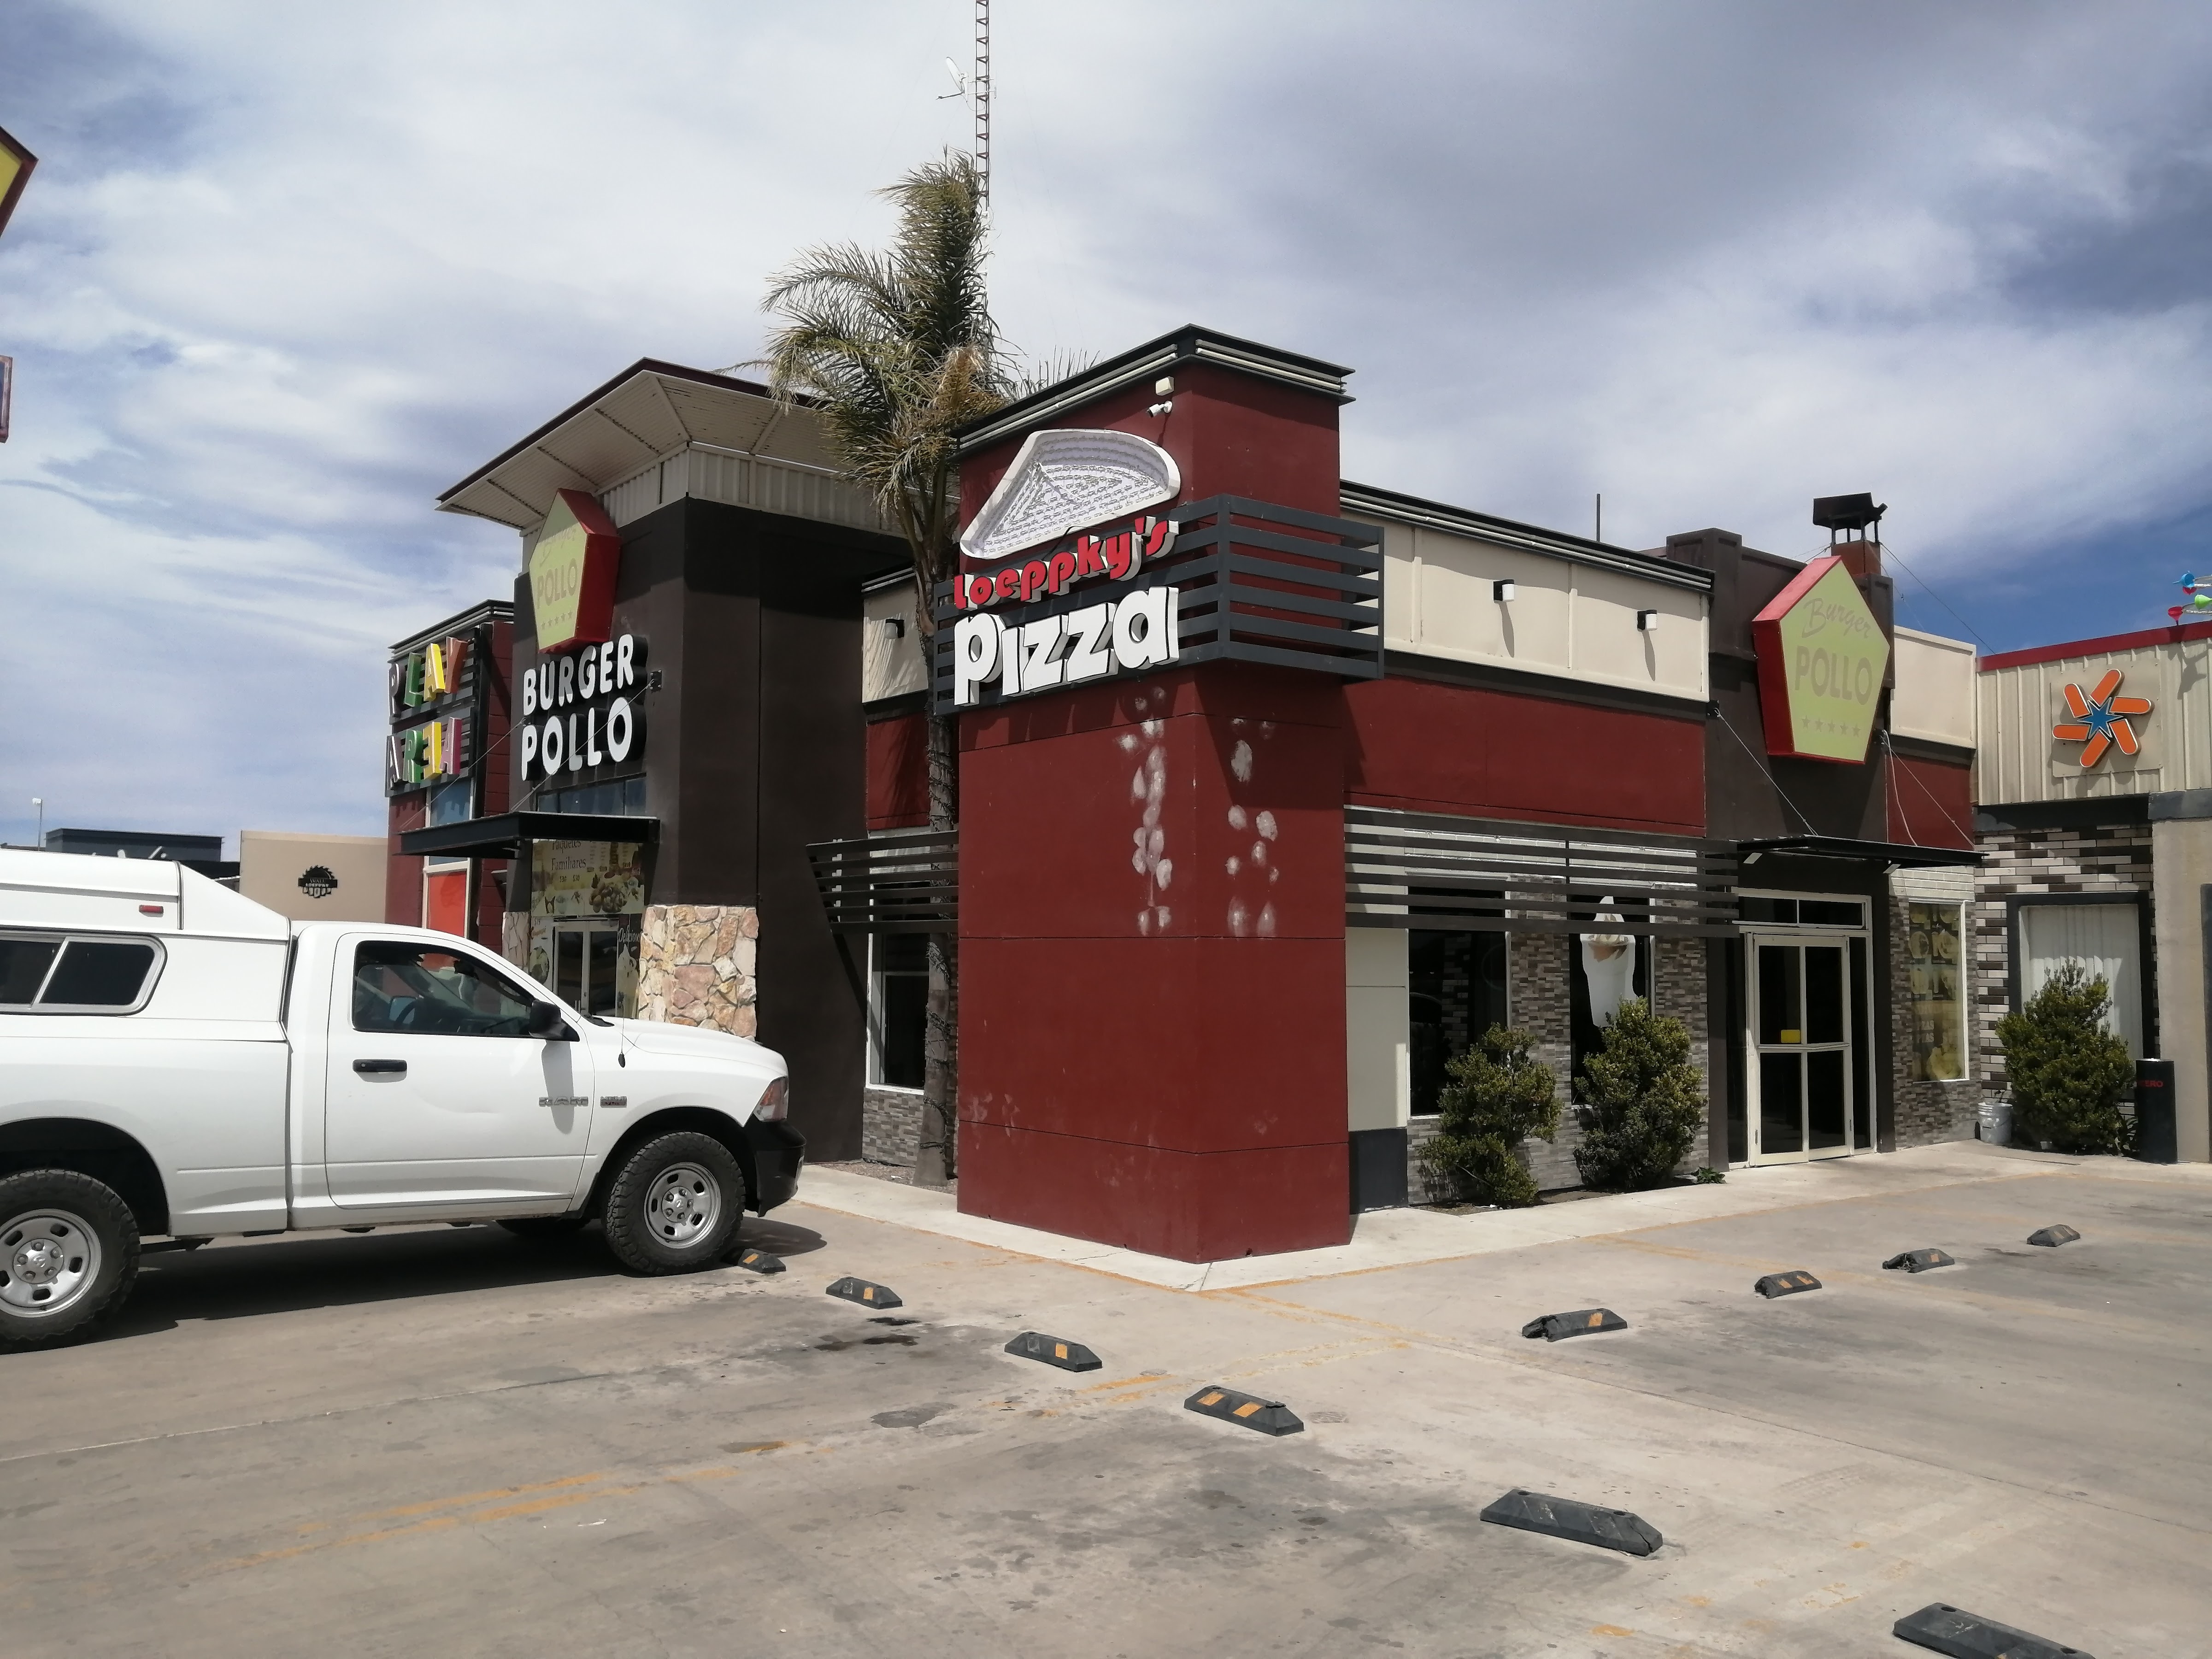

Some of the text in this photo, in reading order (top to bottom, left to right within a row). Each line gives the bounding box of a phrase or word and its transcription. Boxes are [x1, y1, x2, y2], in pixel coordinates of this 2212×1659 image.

[536, 558, 577, 610] POLLO
[954, 586, 1179, 706] Pizza
[1801, 598, 1871, 639] Burger
[388, 636, 468, 718] PLAY
[523, 634, 635, 716] BURGER
[1794, 645, 1873, 706] POLLO
[386, 717, 462, 790] AREA
[522, 697, 634, 781] POLLO
[551, 856, 587, 871] Familiares
[539, 1096, 588, 1107] RAM
